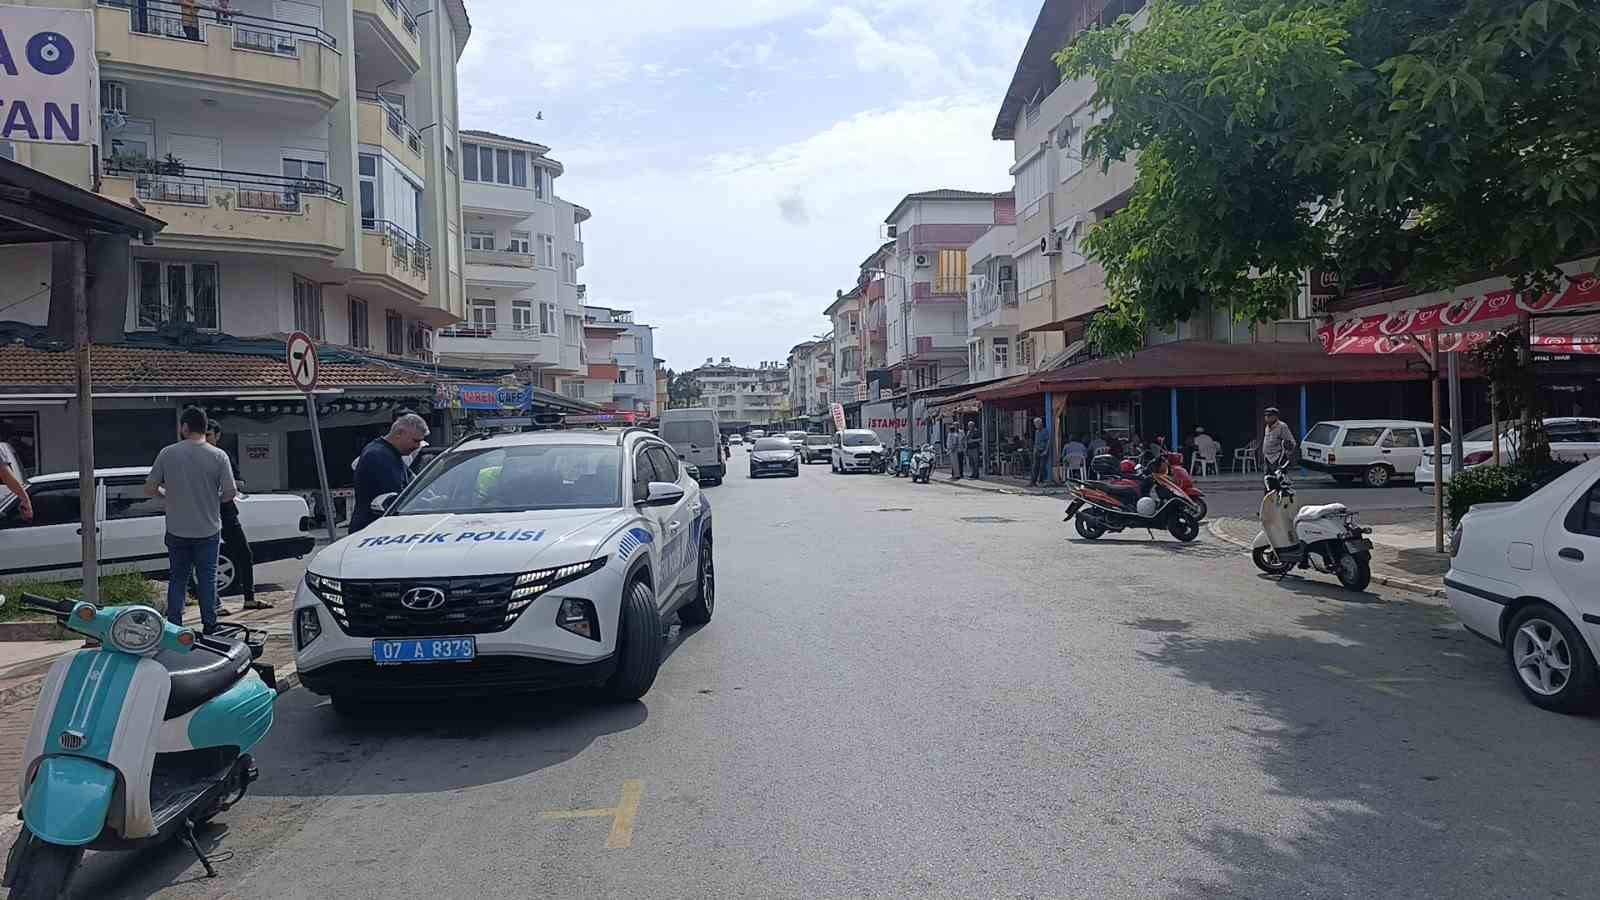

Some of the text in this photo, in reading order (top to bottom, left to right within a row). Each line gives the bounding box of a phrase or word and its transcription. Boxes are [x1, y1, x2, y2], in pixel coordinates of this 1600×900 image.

[0, 100, 80, 141] AN
[383, 642, 402, 659] 07
[414, 642, 425, 658] A
